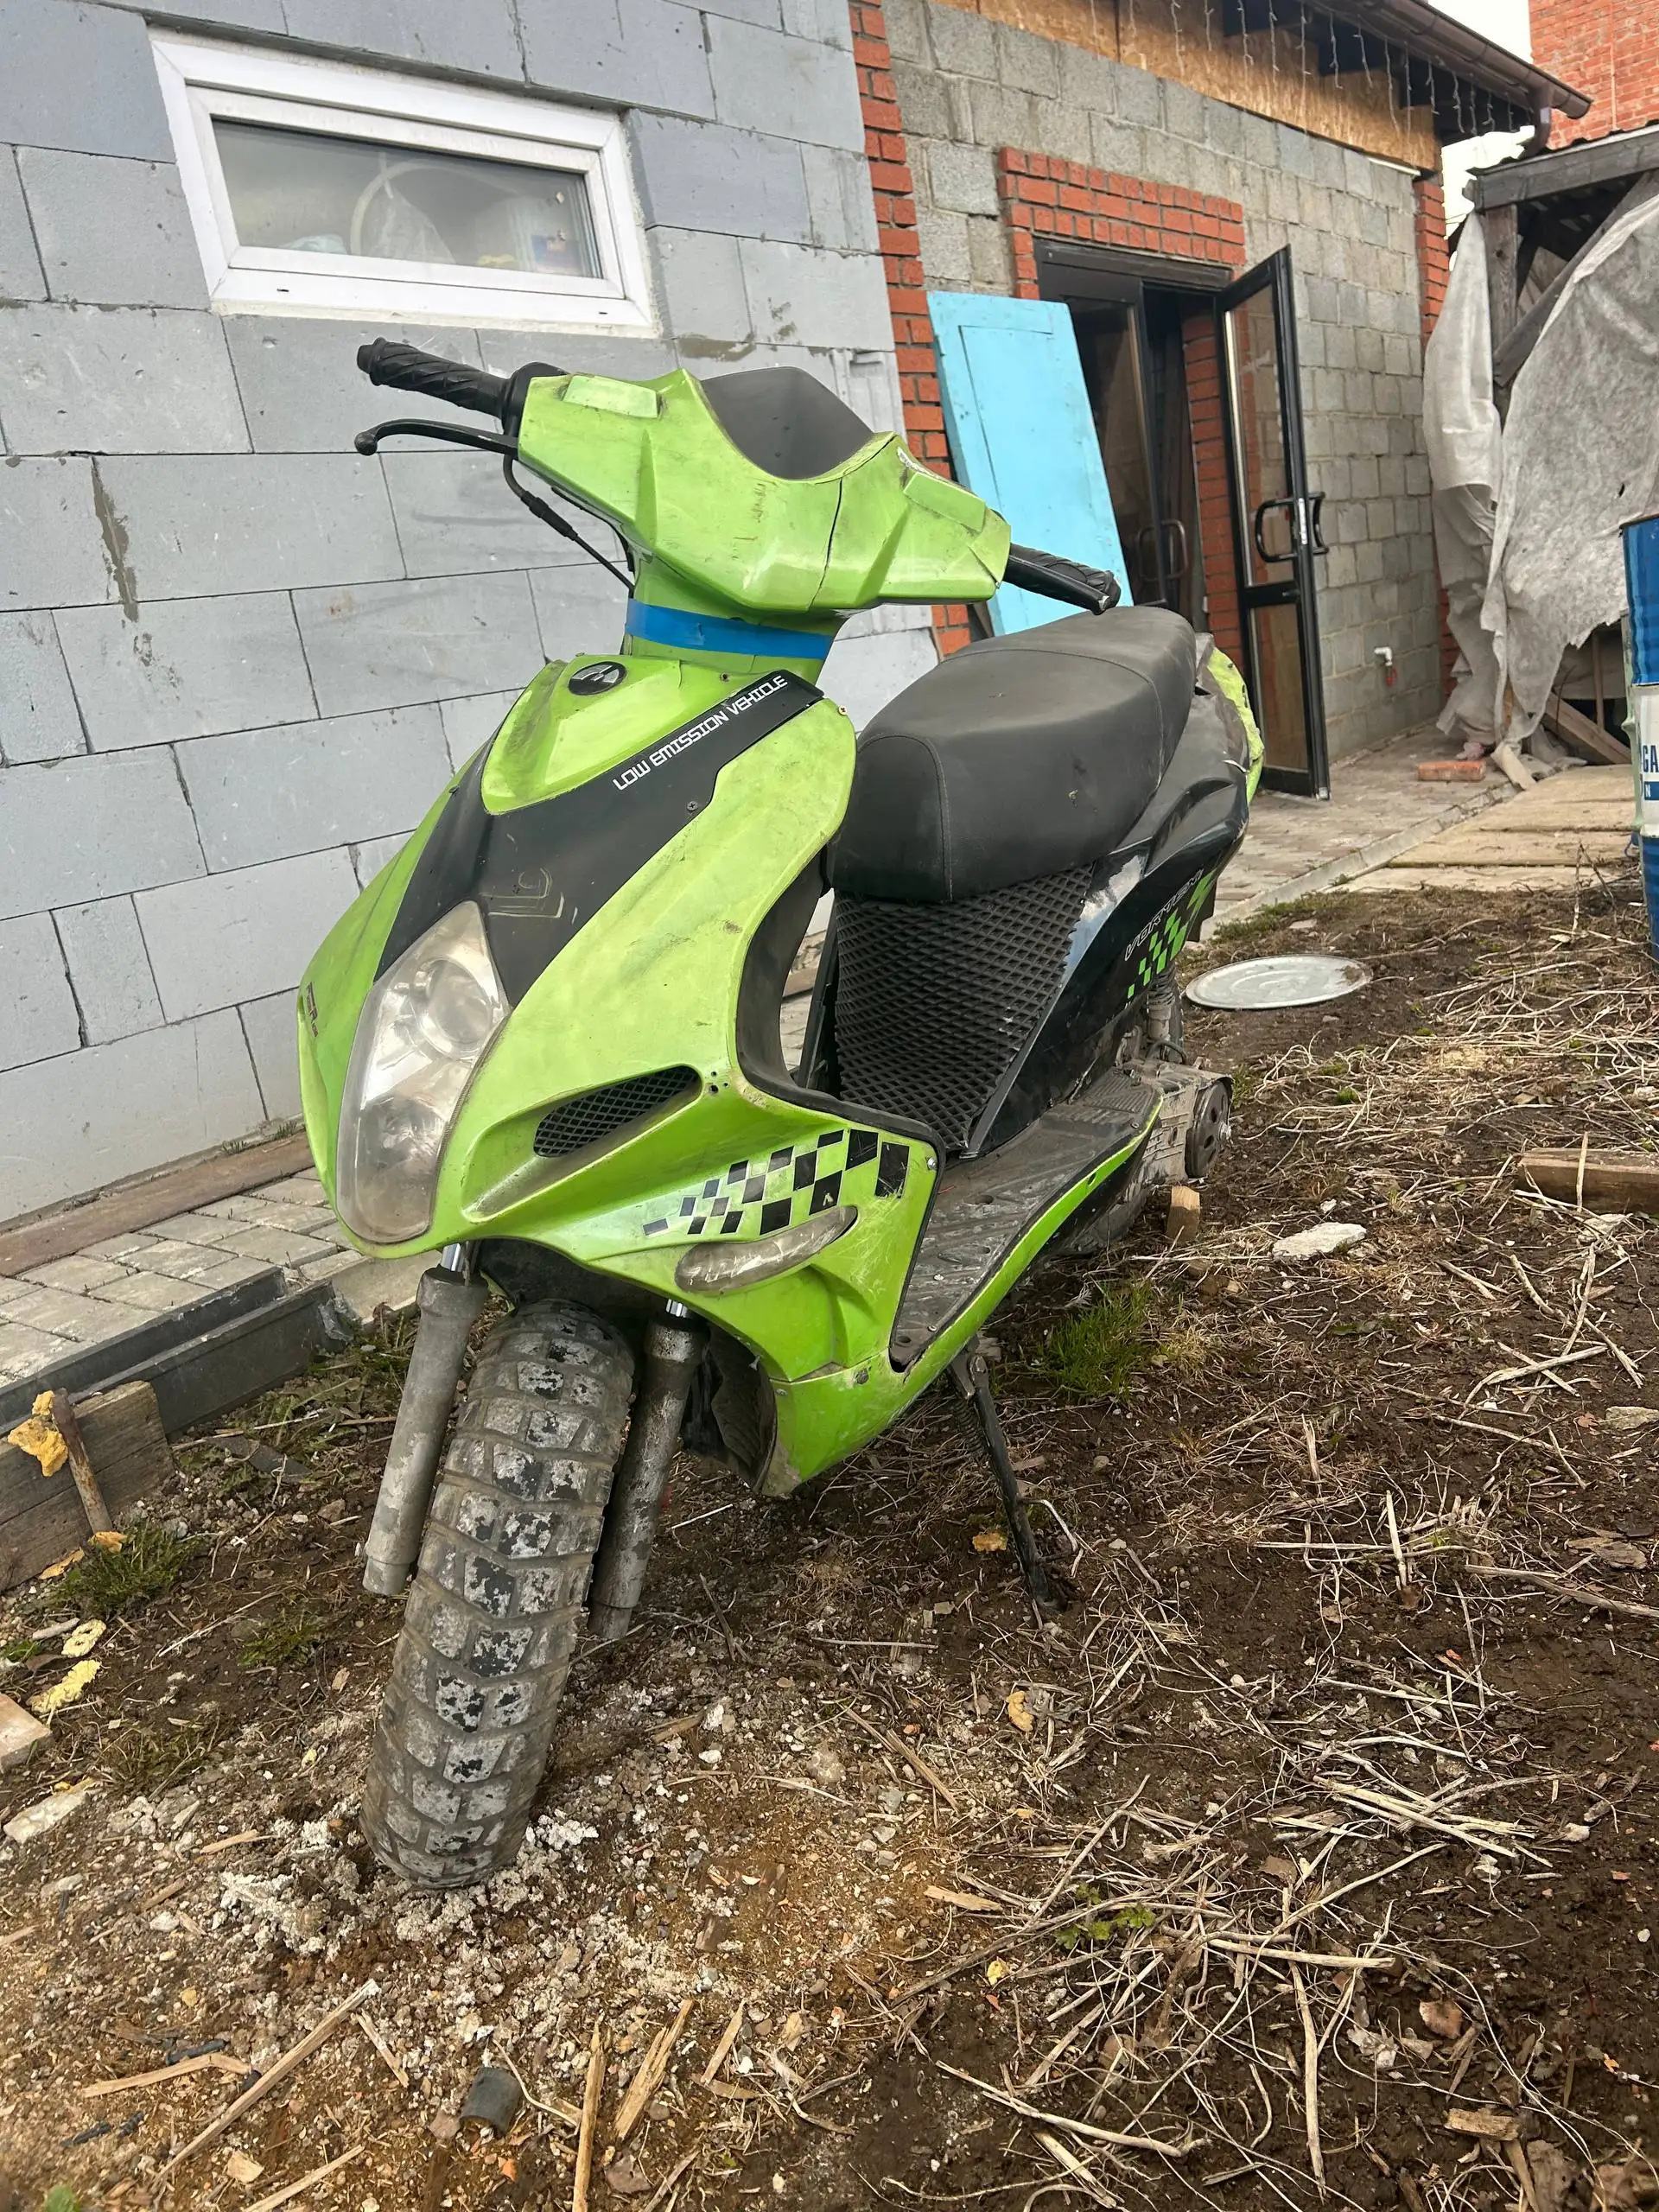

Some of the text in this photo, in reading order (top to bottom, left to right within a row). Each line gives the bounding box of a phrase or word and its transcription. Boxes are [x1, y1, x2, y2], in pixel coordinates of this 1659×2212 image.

[613, 676, 788, 791] LOW EMISSION VEHICLE
